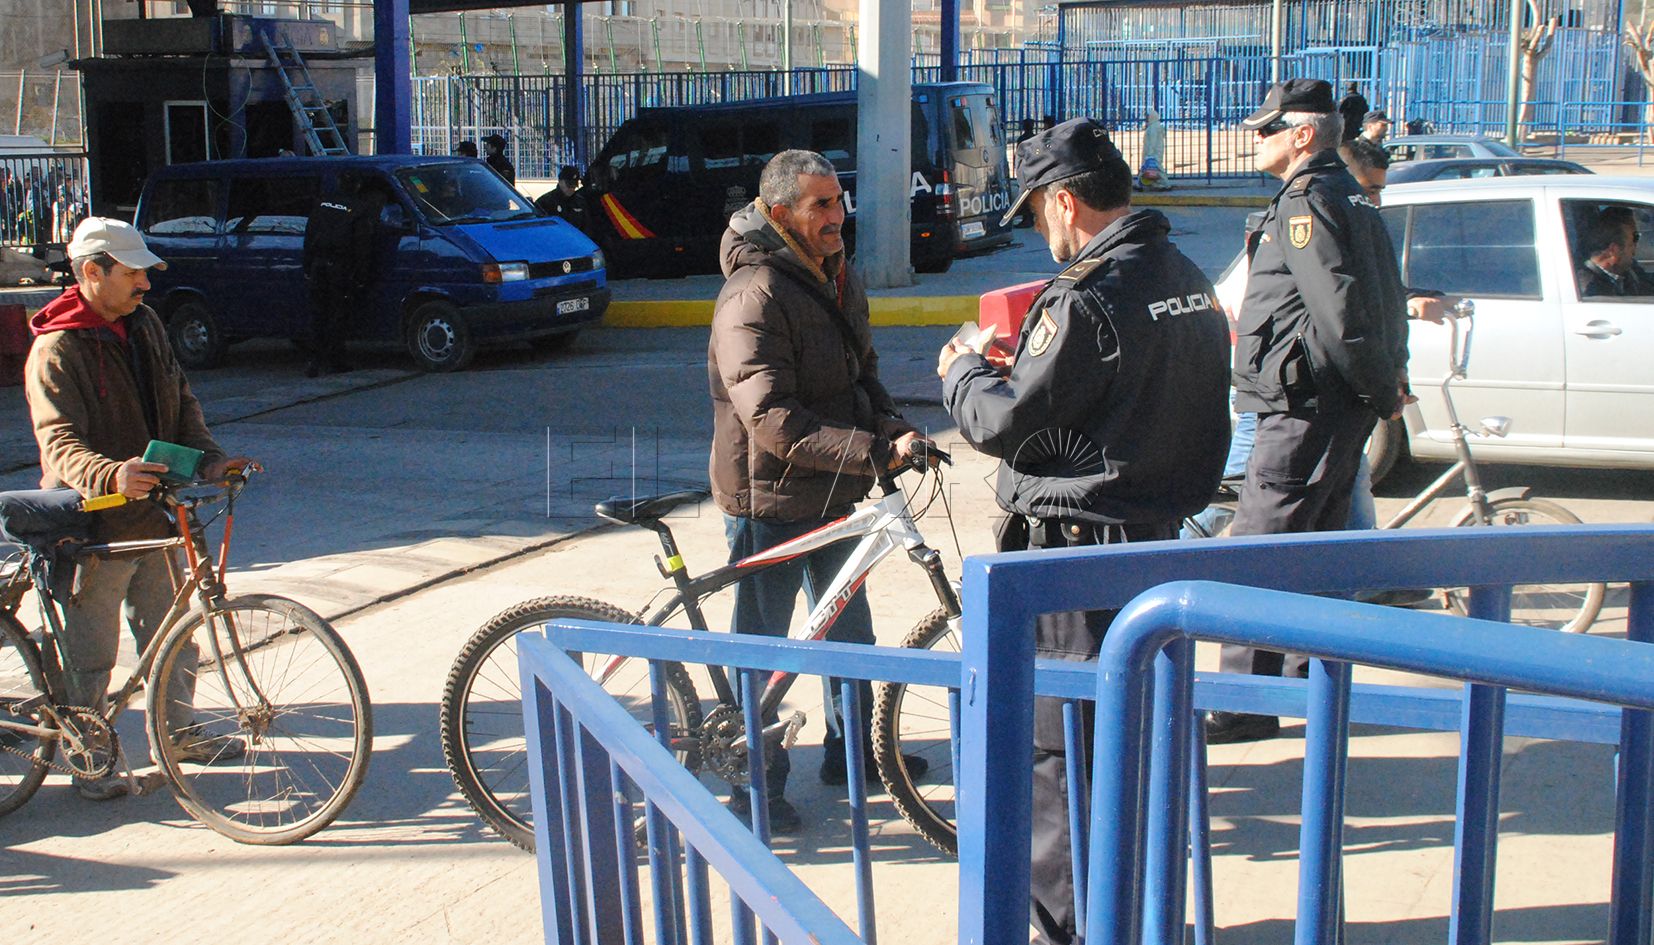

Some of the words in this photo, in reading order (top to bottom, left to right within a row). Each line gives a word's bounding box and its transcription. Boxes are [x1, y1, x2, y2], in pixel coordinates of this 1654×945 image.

[320, 202, 347, 211] POLICIA
[960, 192, 1010, 217] POLICIA
[1148, 293, 1214, 321] POLICIA
